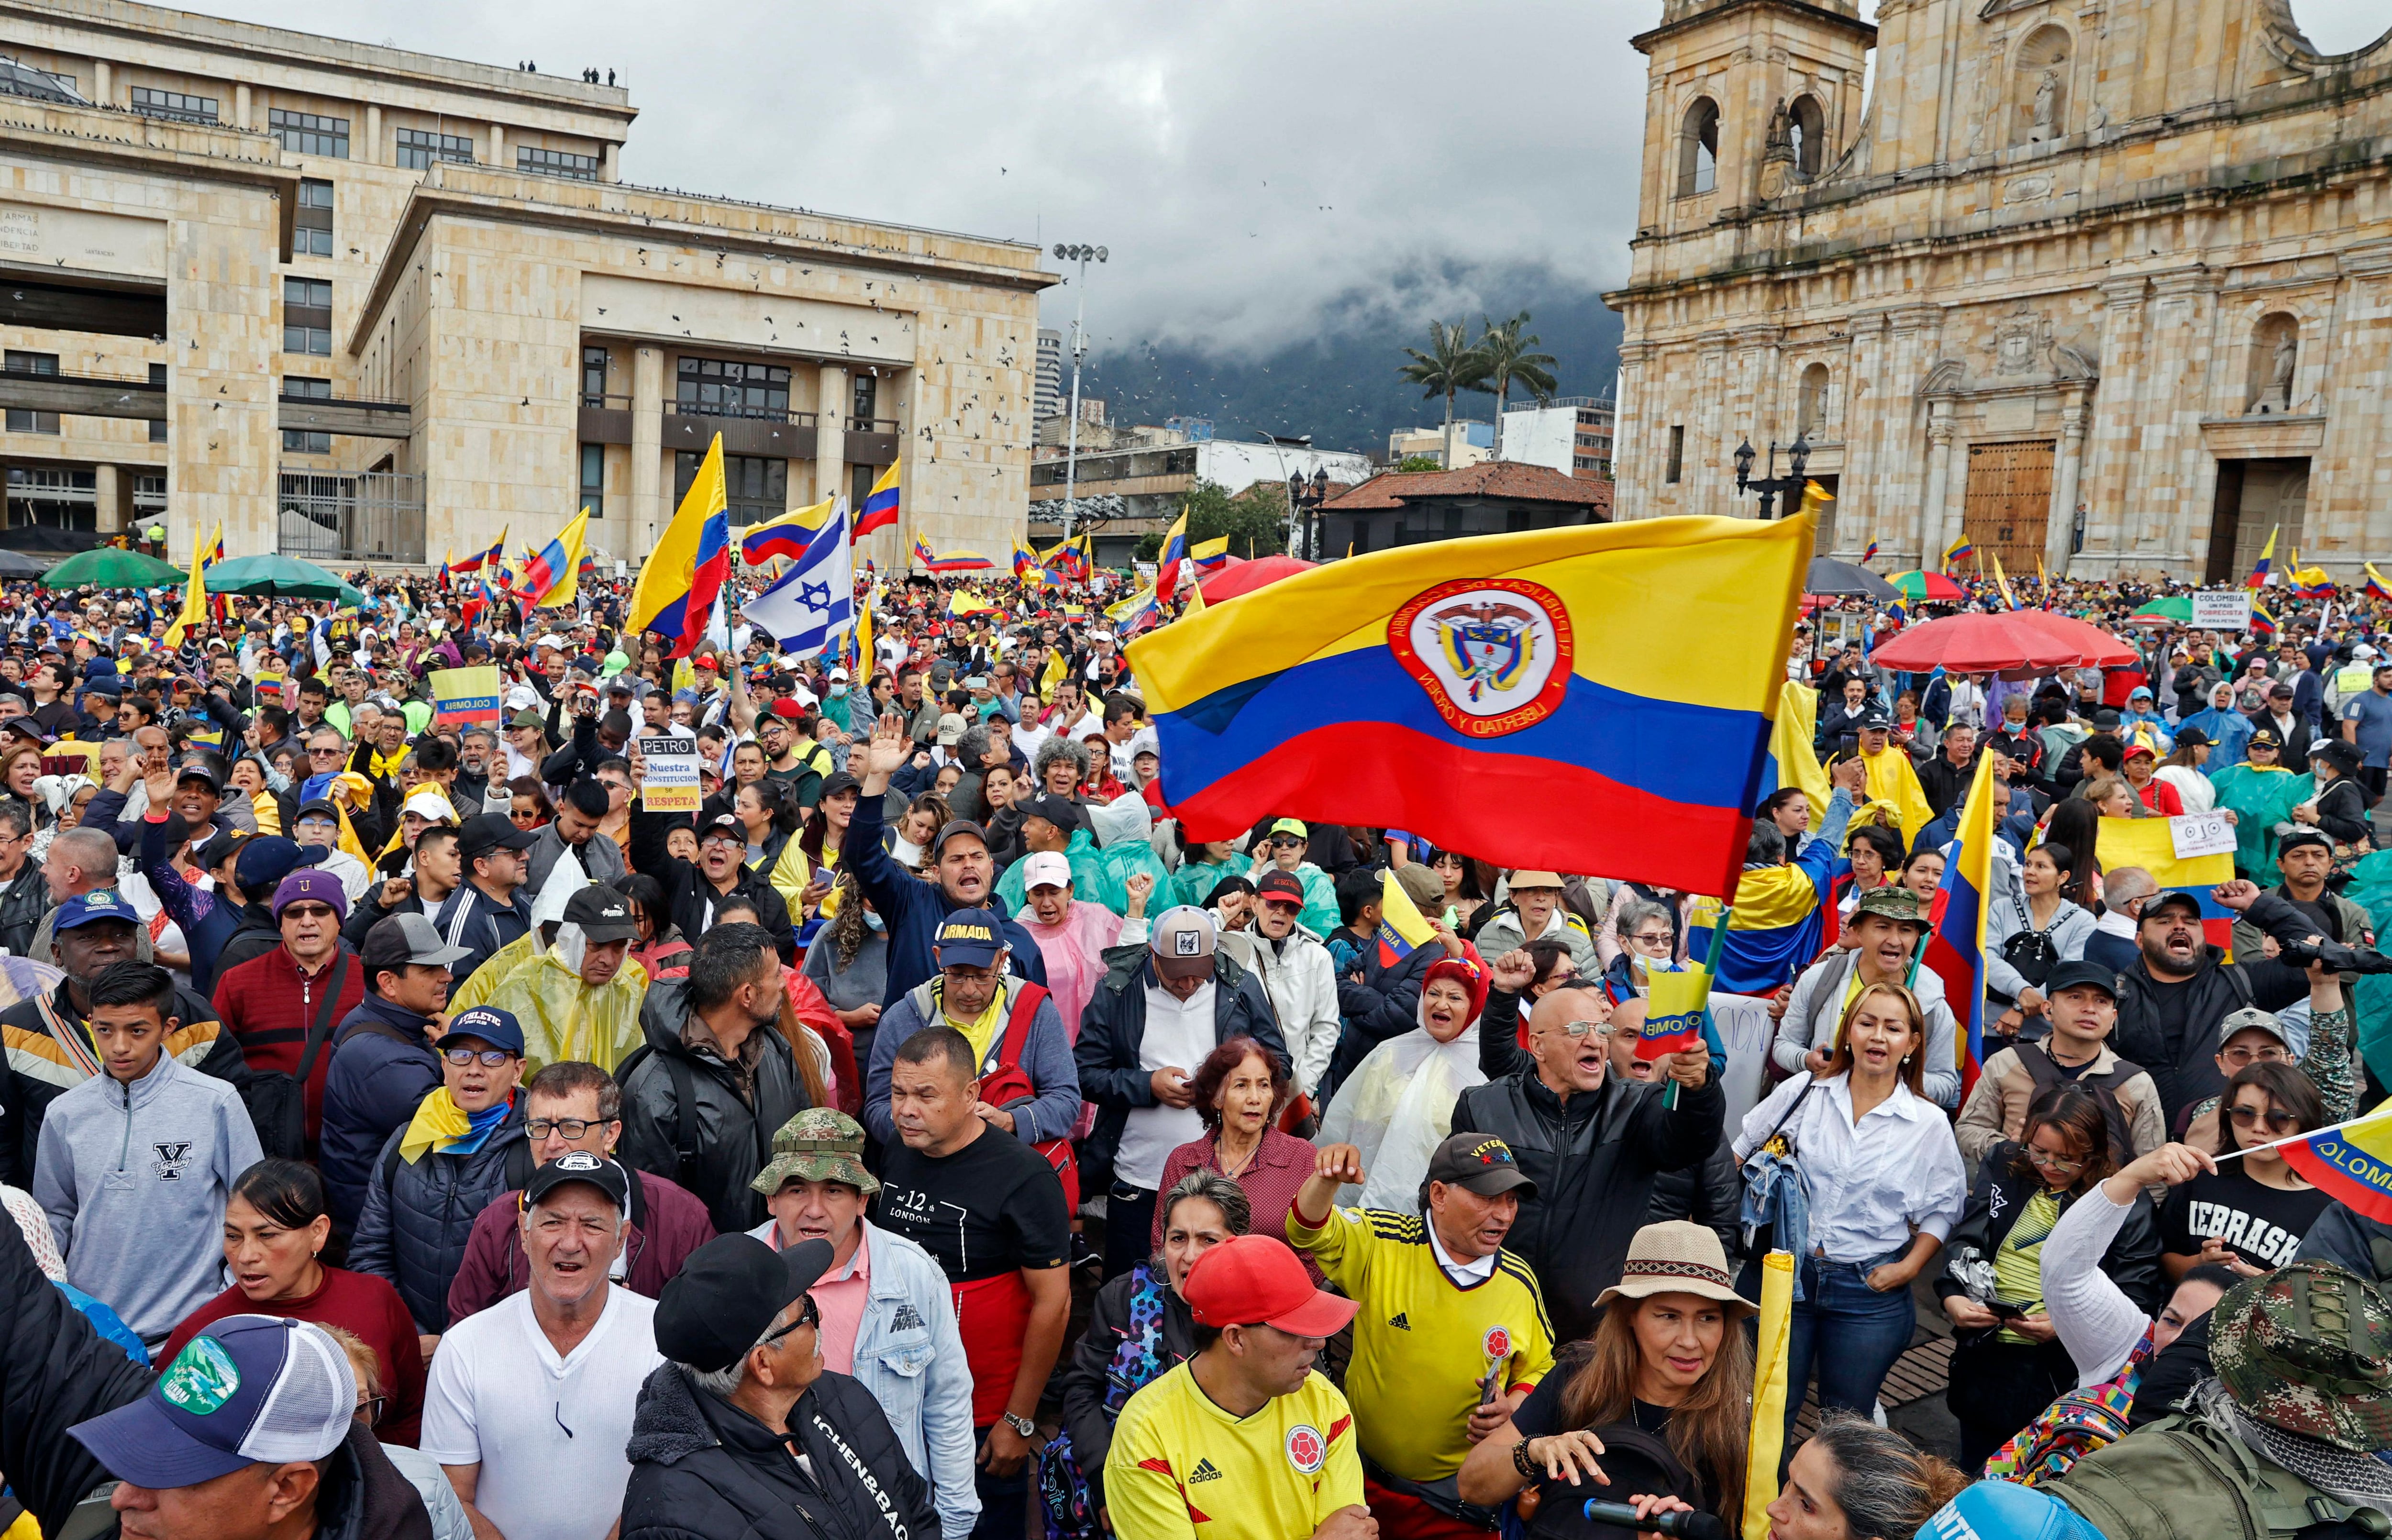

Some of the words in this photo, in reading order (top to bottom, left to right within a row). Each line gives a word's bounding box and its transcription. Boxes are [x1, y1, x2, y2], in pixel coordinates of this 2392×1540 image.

[5, 213, 38, 223] ARMAS
[85, 248, 115, 257] SANTANDER
[643, 740, 689, 753] PETRO
[649, 763, 690, 772] Nuestra
[646, 797, 697, 806] RESPETA
[299, 880, 310, 892] U
[941, 924, 992, 941] ARMADA
[457, 1011, 501, 1027] ATHLETIC
[151, 1157, 192, 1175] Yachting
[905, 1190, 926, 1211] 12
[929, 1204, 935, 1212] th
[889, 1207, 932, 1225] LONDON
[1388, 1320, 1411, 1331] adidas
[2080, 1389, 2098, 1398] TOTTO
[1189, 1470, 1223, 1484] adidas
